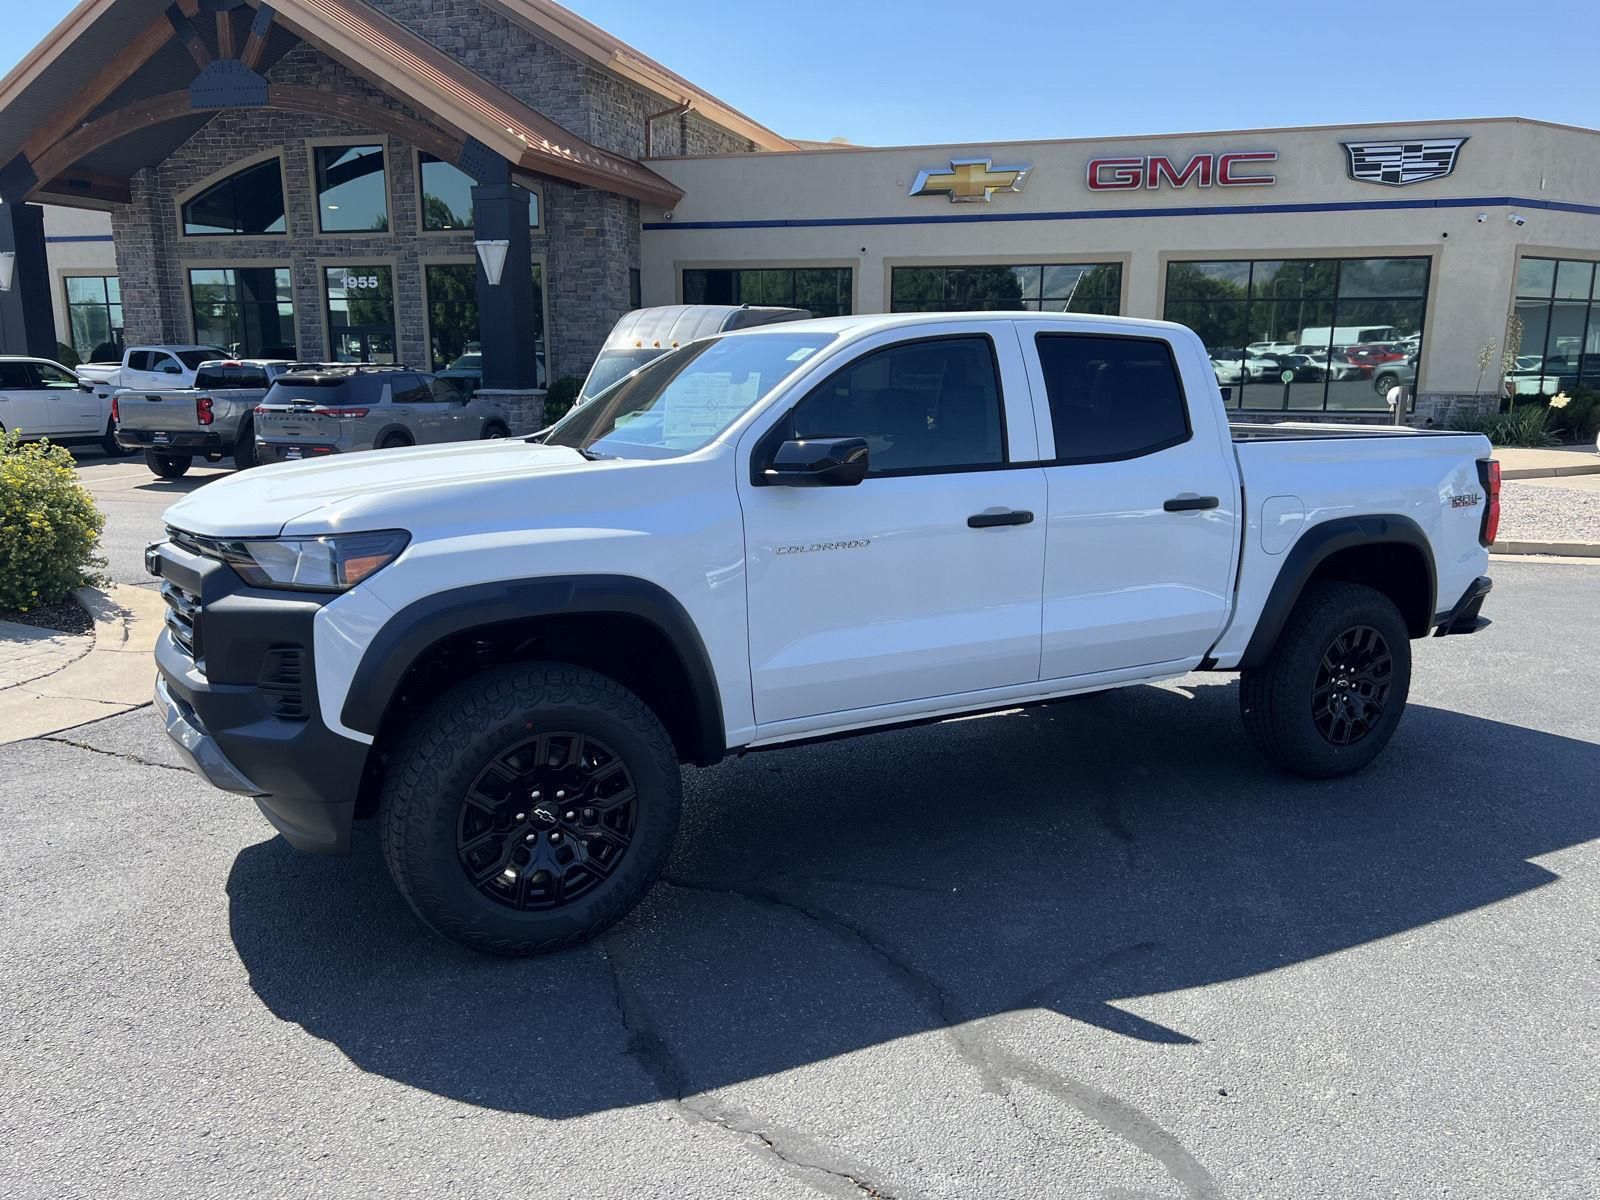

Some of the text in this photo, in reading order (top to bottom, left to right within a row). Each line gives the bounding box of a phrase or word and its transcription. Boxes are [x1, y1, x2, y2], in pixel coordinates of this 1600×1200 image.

[1086, 152, 1278, 191] GMC
[341, 276, 378, 289] 1955
[1448, 493, 1482, 503] TRAIL
[1452, 500, 1477, 508] BOSS
[776, 539, 871, 555] COLORADO
